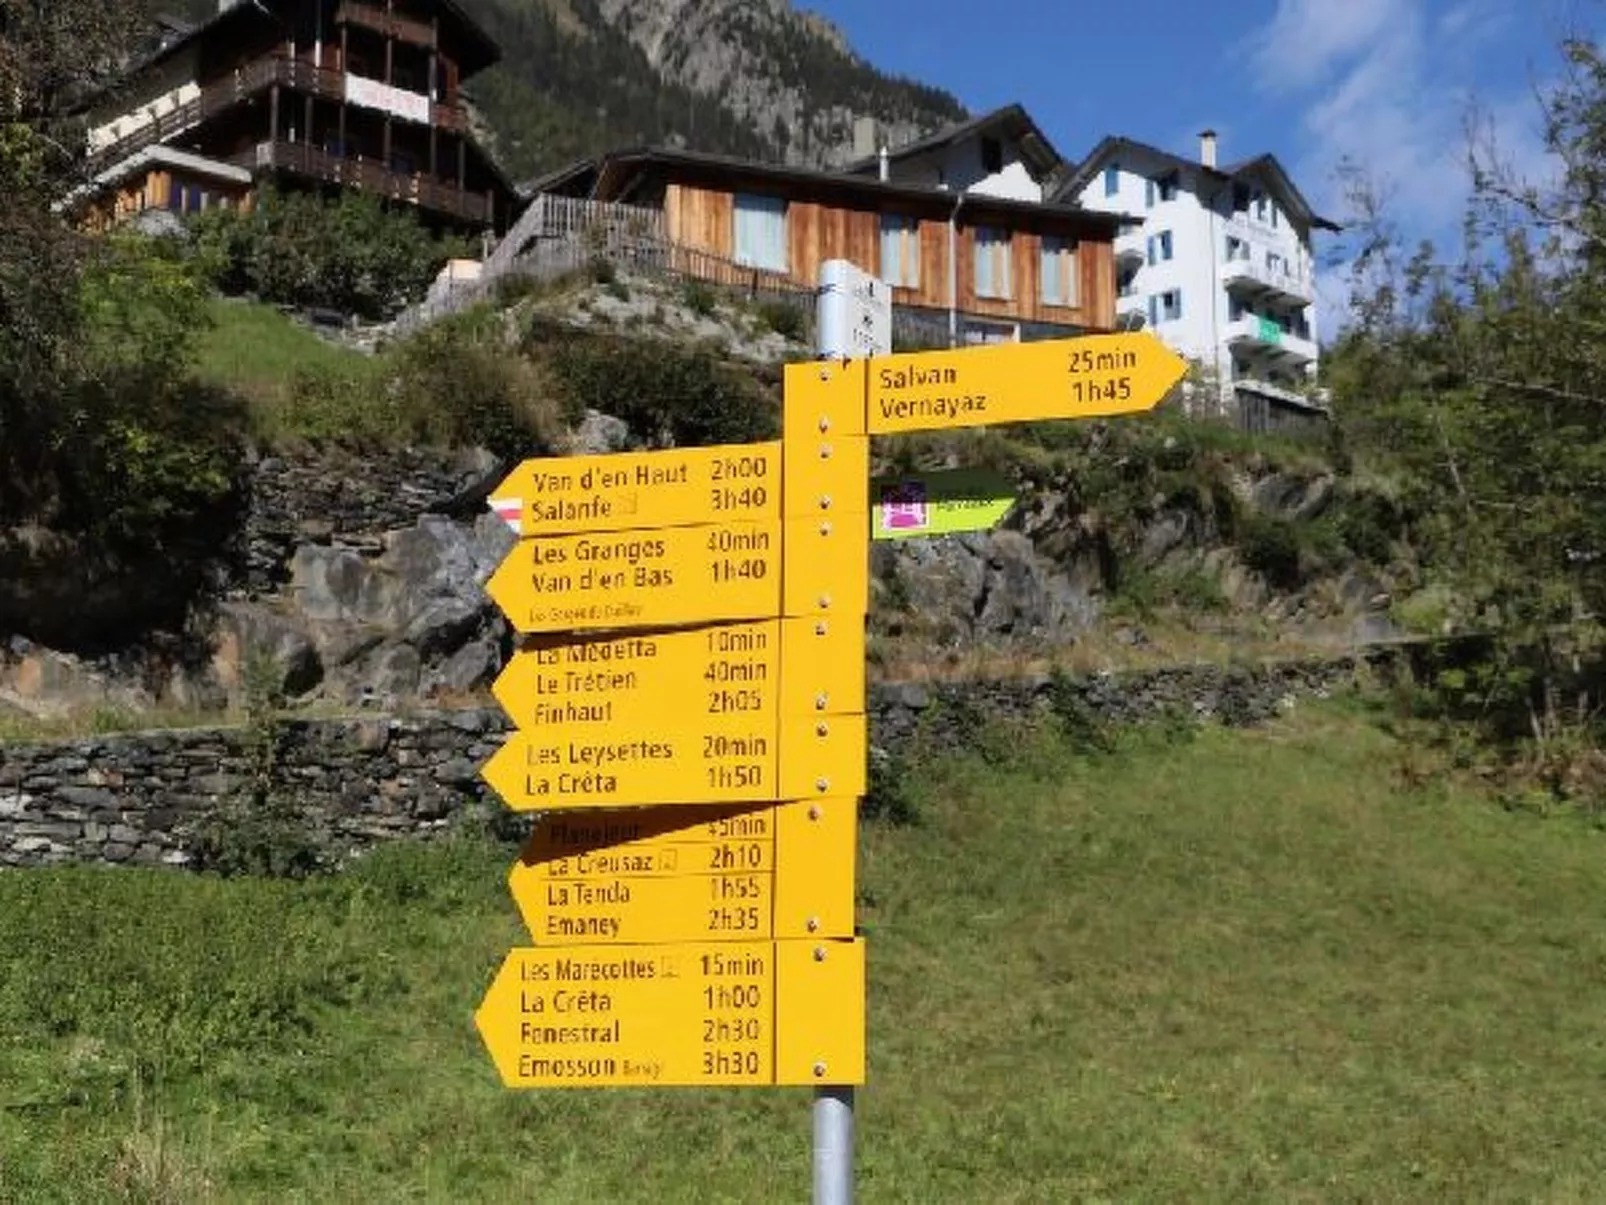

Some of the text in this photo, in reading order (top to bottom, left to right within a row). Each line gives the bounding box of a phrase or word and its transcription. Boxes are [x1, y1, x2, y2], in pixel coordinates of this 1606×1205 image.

[1068, 348, 1138, 373] 25min
[880, 365, 957, 389] Salvan
[1073, 377, 1132, 403] 1h45
[880, 394, 987, 420] Vernayaz
[532, 463, 688, 493] Van d'en Haut
[710, 456, 767, 480] 2h00
[532, 497, 612, 523] Salanfe
[710, 487, 767, 511] 3h40
[533, 538, 666, 566] Les Granges
[706, 530, 770, 553] 40min
[531, 565, 674, 594] Van d'en Bas
[710, 559, 767, 582] 1h40
[706, 629, 767, 652] 10min
[536, 648, 560, 665] La
[536, 669, 638, 695] Le Trétien
[703, 660, 767, 682] 40min
[707, 688, 762, 713] 2h05
[534, 701, 613, 726] Finhaut
[526, 740, 673, 767] Les Leysettes
[703, 735, 768, 758] 20min
[525, 773, 550, 796] La
[707, 765, 762, 788] 1h50
[577, 852, 653, 874] Creusaz
[708, 843, 762, 869] 2h10
[547, 882, 569, 906] La
[709, 873, 761, 898] 1h55
[547, 914, 622, 938] Emaney
[707, 905, 760, 931] 2h35
[520, 959, 551, 982] Les
[700, 952, 765, 978] 15min
[520, 990, 545, 1013] La
[702, 984, 762, 1009] 1h00
[520, 1020, 621, 1044] Fenestral
[702, 1018, 760, 1043] 2h30
[518, 1054, 616, 1078] Emosson
[702, 1050, 760, 1076] 3h30
